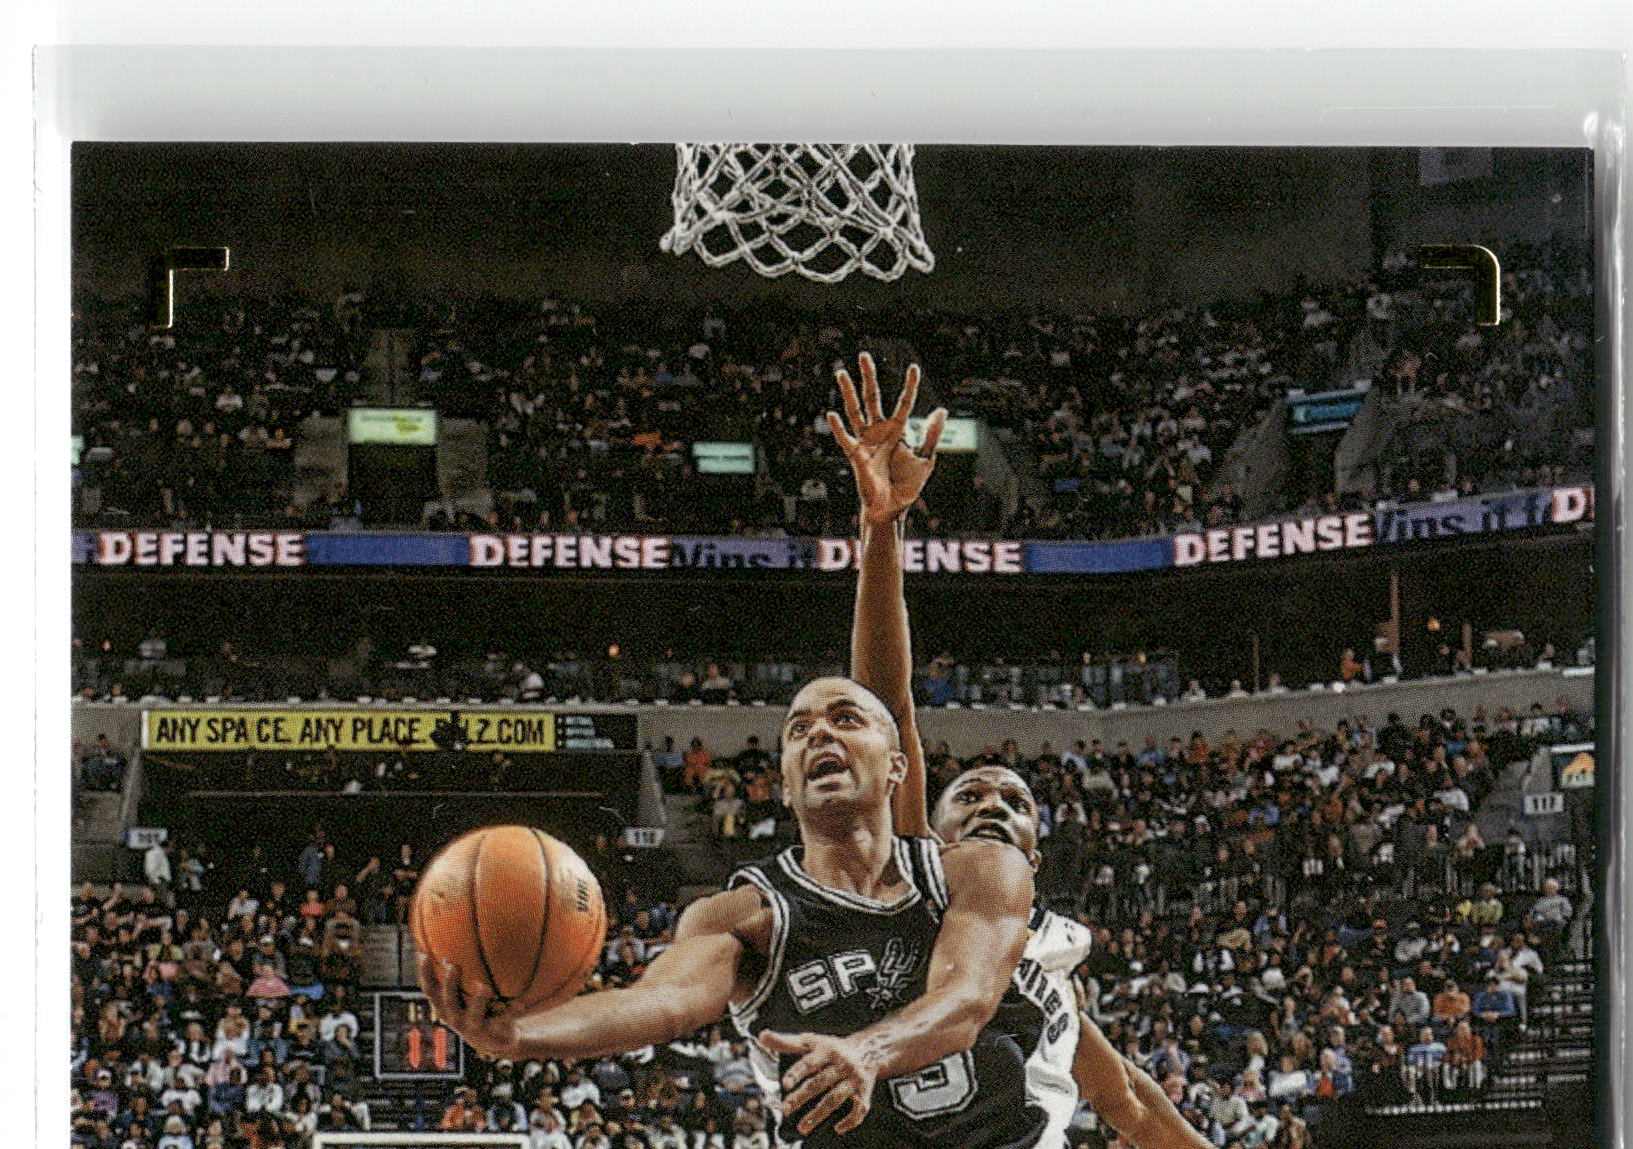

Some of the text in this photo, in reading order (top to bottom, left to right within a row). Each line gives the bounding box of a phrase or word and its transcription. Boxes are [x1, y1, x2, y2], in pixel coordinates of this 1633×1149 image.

[98, 530, 305, 566] DEFENSE
[469, 534, 671, 568] DEFENSE
[817, 538, 1025, 574] DENSE
[1174, 513, 1374, 567] DEFENSE
[155, 717, 200, 743] ANY
[300, 717, 344, 743] ANY
